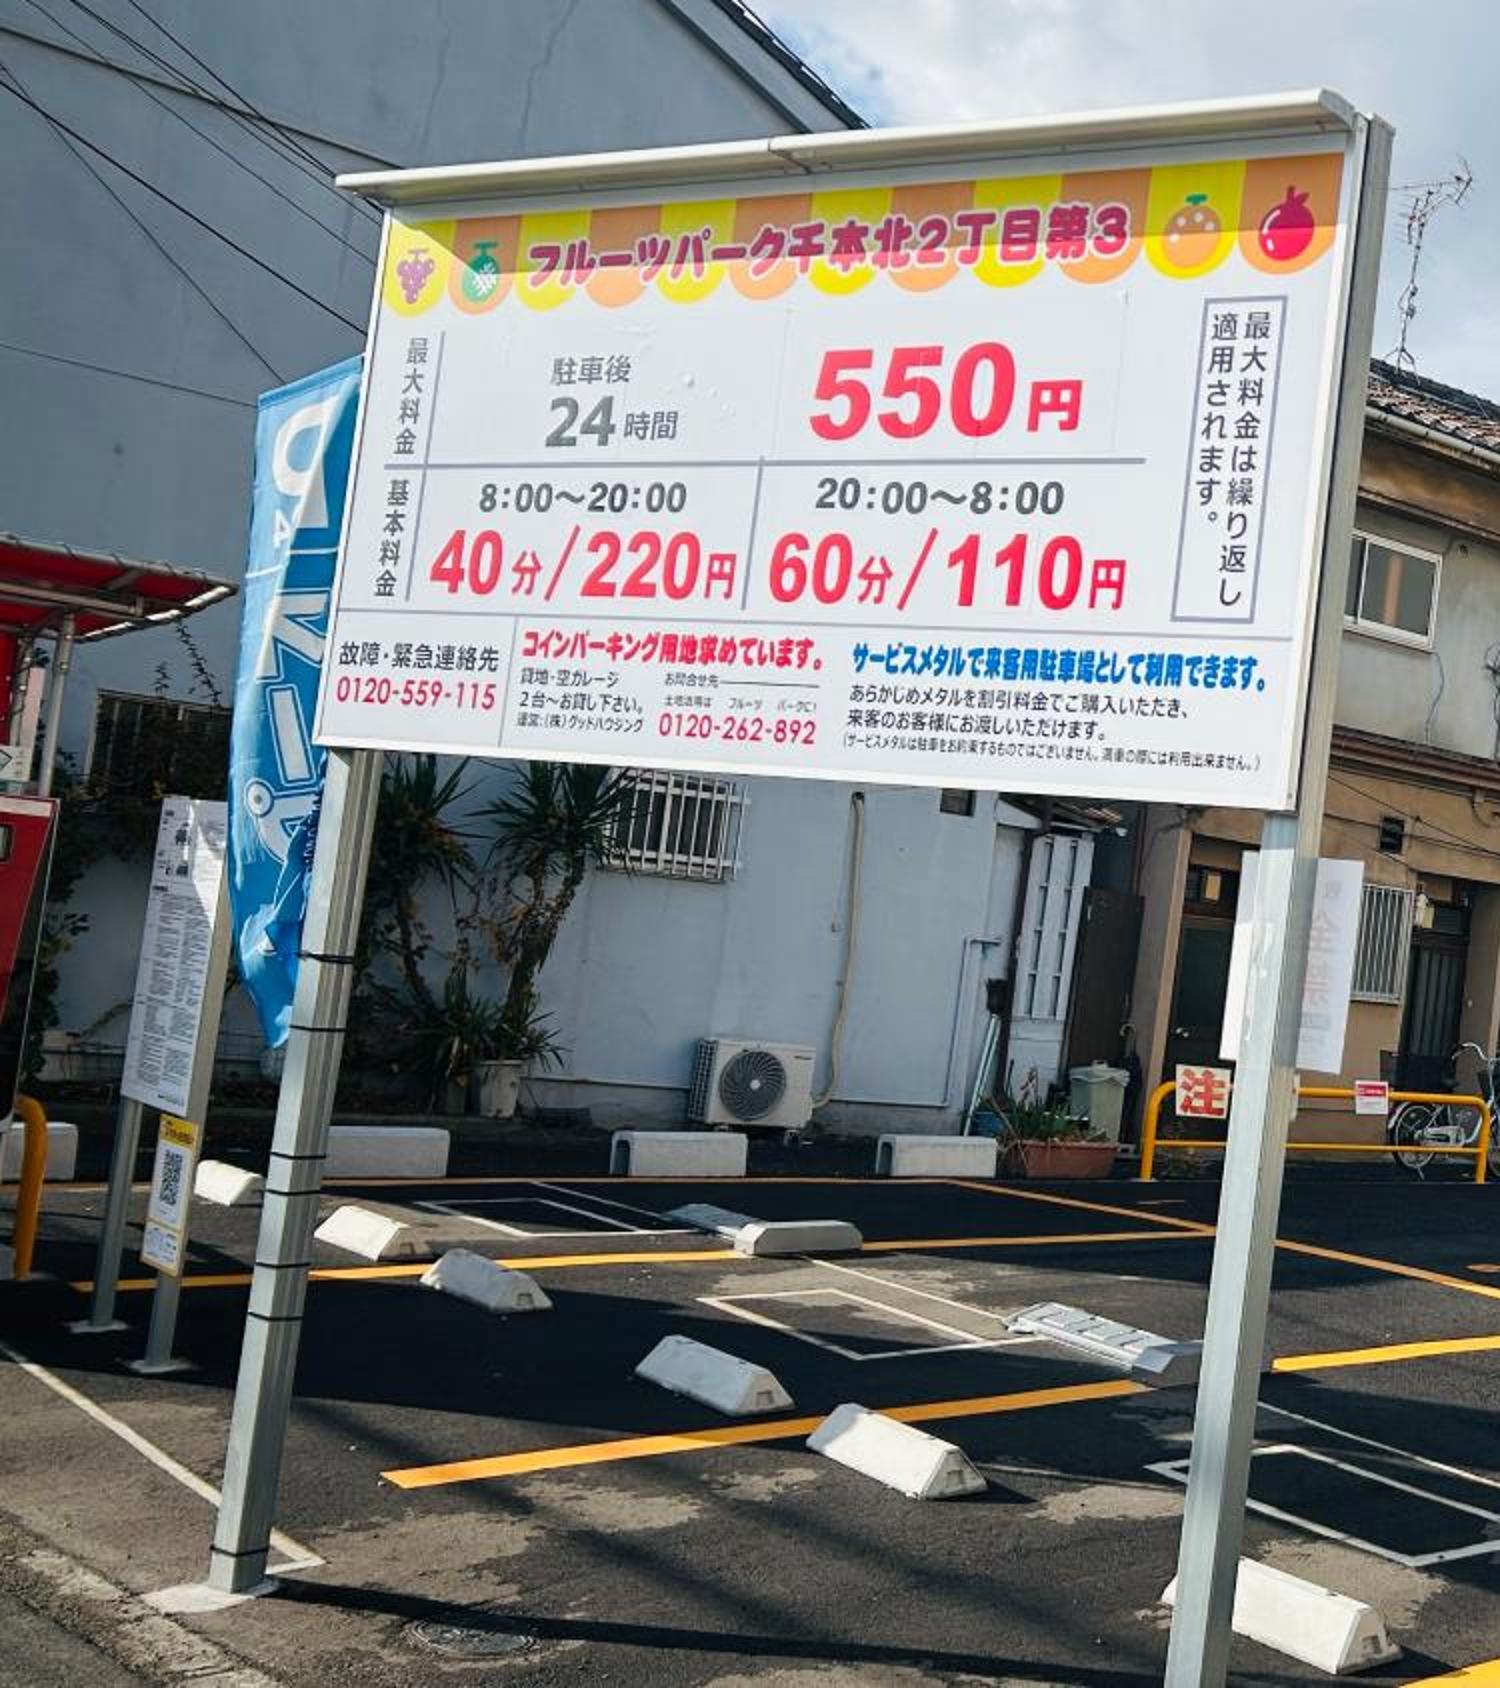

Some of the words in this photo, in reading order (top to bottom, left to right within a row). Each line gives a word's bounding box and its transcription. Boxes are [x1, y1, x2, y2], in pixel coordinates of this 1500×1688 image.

[528, 204, 1129, 288] フルーツパーク千本北2丁目第3
[551, 354, 632, 386] 駐車後
[808, 341, 1084, 441] 550円
[393, 337, 429, 456] 最大料金
[1196, 311, 1239, 525] 適用されます。
[1218, 310, 1271, 608] 最大料金は繰り返し
[373, 479, 409, 598] 基本料金
[338, 641, 500, 672] 故障・緊急連絡先
[522, 630, 824, 672] コインパーキング用地求めています。
[852, 642, 1266, 693] サービスメタルで来客用駐車場として利用できます。
[336, 675, 498, 710] 0120-559-115
[849, 684, 1189, 719] あらかじめメタルを割引料金でご購入いただき、
[658, 712, 817, 745] 0120-262-892
[847, 708, 1106, 742] 来客のお客様にお渡しいただけます。
[1180, 1068, 1226, 1117] 注
